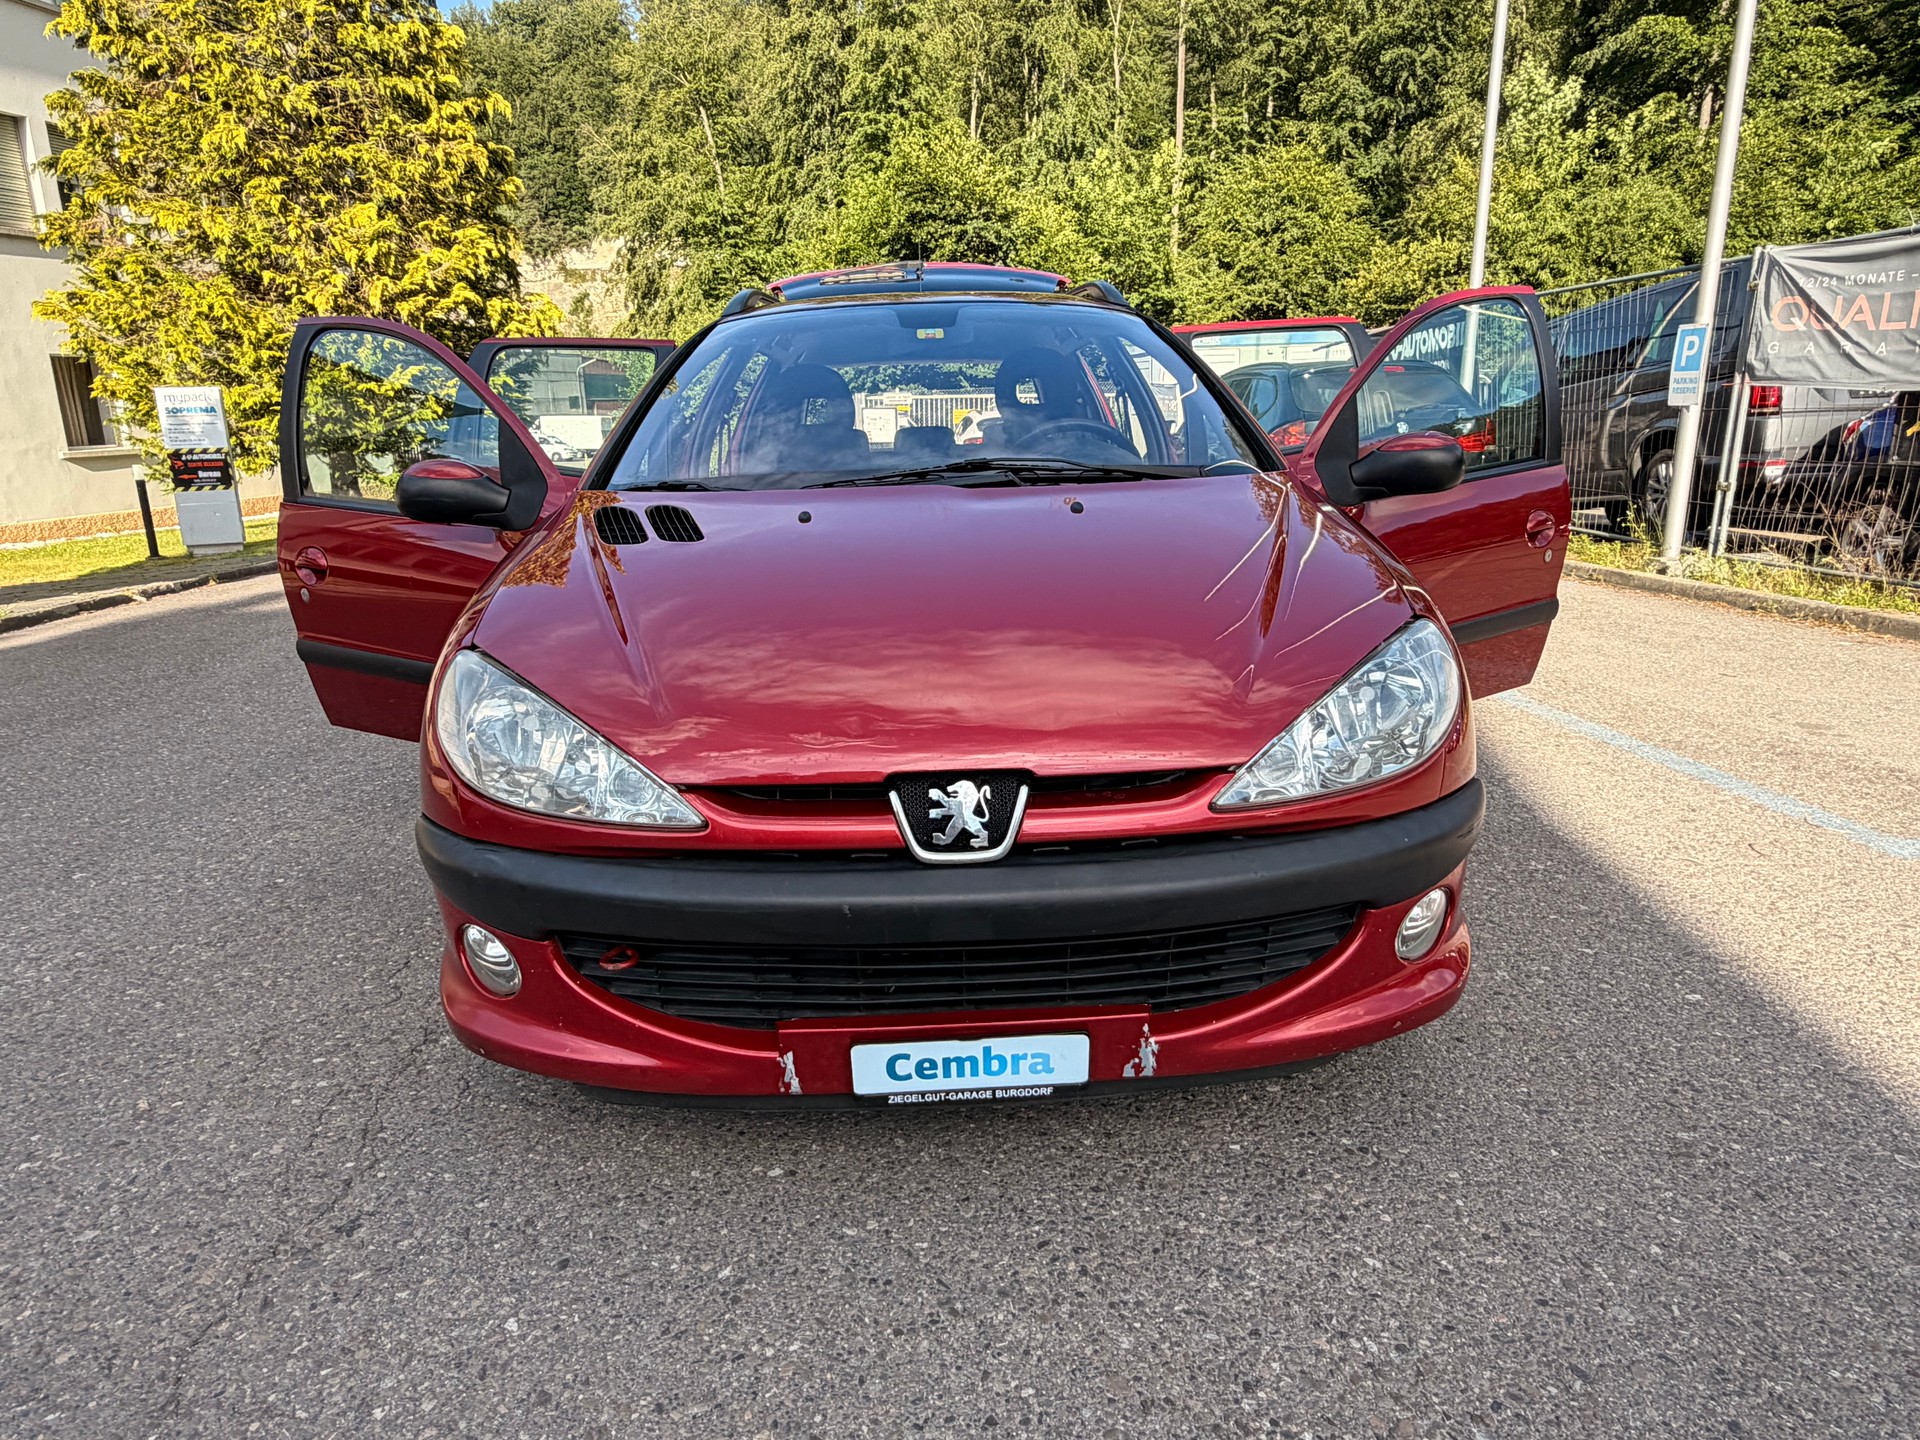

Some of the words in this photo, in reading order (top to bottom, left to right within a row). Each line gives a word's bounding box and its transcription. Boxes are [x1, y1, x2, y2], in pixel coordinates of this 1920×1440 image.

[1845, 270, 1905, 286] MONATE
[1681, 335, 1700, 367] P
[1673, 377, 1698, 385] PARKING
[164, 390, 213, 405] mypack
[165, 406, 217, 415] SOPREMA
[886, 1046, 1055, 1081] Cembra
[888, 1090, 993, 1104] ZIEGELGUT-GARAGE
[995, 1087, 1054, 1098] BURGDORF
